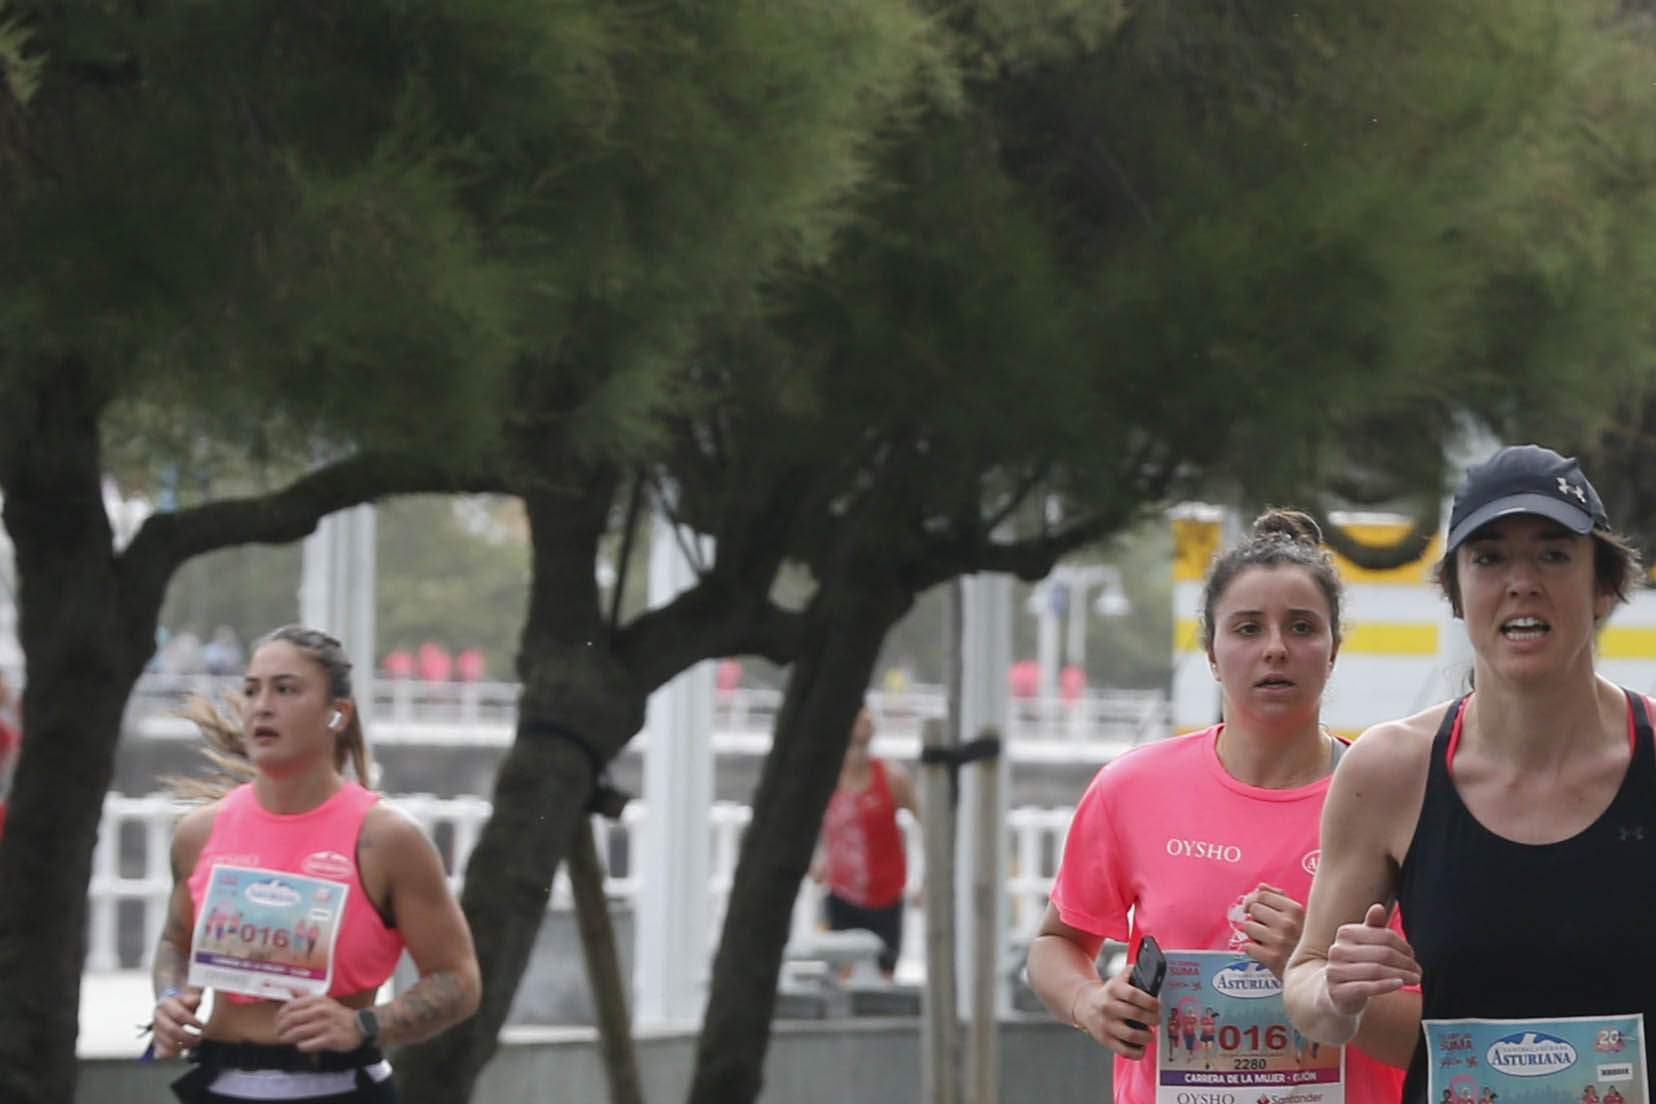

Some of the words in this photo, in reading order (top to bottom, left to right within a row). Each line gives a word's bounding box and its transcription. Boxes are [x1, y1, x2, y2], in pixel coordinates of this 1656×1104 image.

[1166, 838, 1242, 863] OYSHO
[240, 923, 289, 949] 016
[1217, 976, 1281, 990] ASTURIAN
[1219, 1025, 1288, 1051] 016
[1234, 1058, 1267, 1070] 2280
[1490, 1049, 1572, 1067] ASTURIANA
[1241, 1074, 1253, 1083] LA
